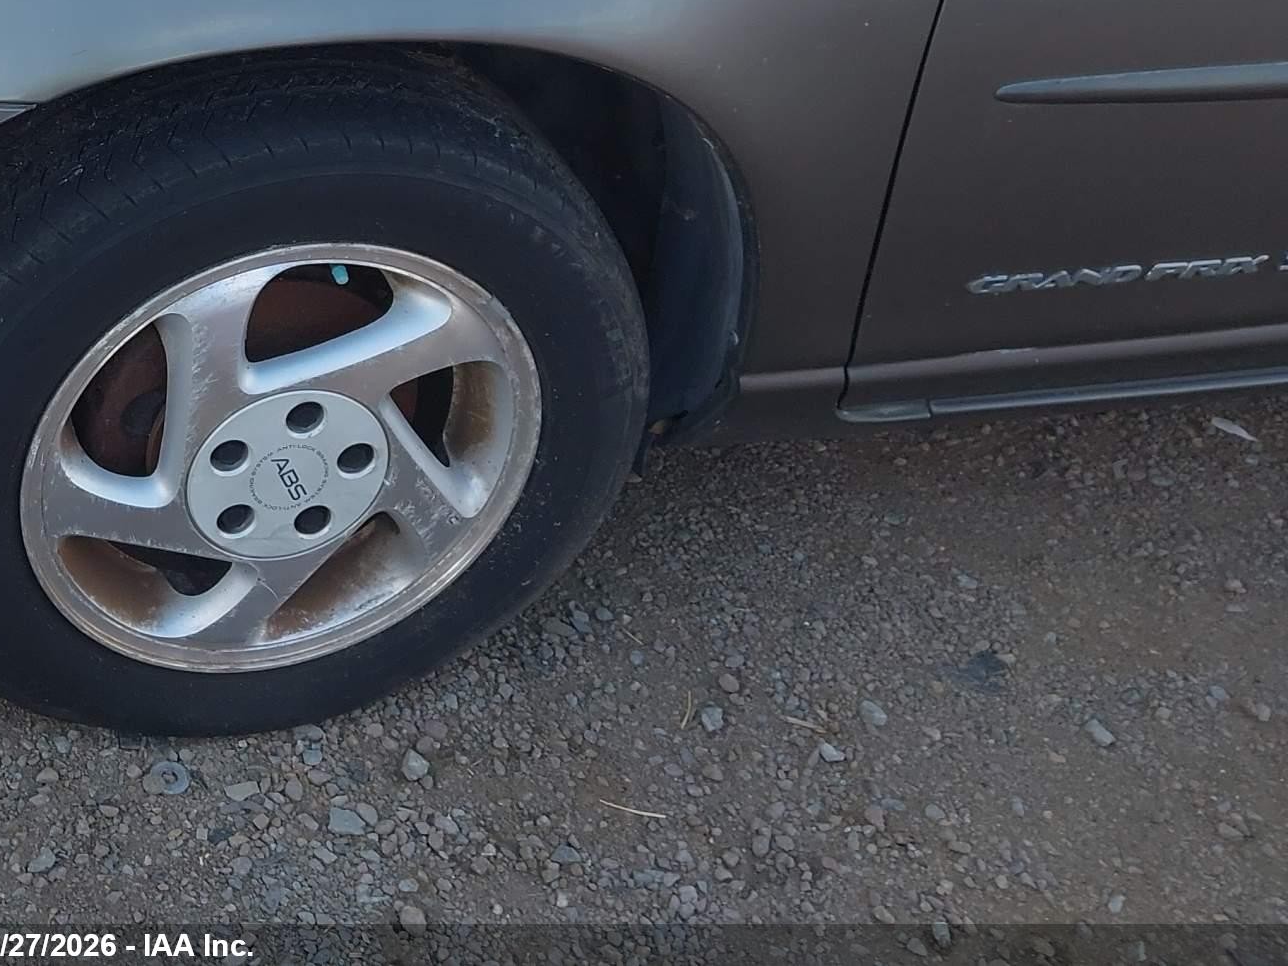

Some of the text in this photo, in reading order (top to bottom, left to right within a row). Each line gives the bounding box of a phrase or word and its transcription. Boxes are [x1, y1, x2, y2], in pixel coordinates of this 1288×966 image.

[965, 263, 1143, 295] GRAND
[1144, 253, 1270, 282] PRIX
[270, 458, 308, 501] ABS
